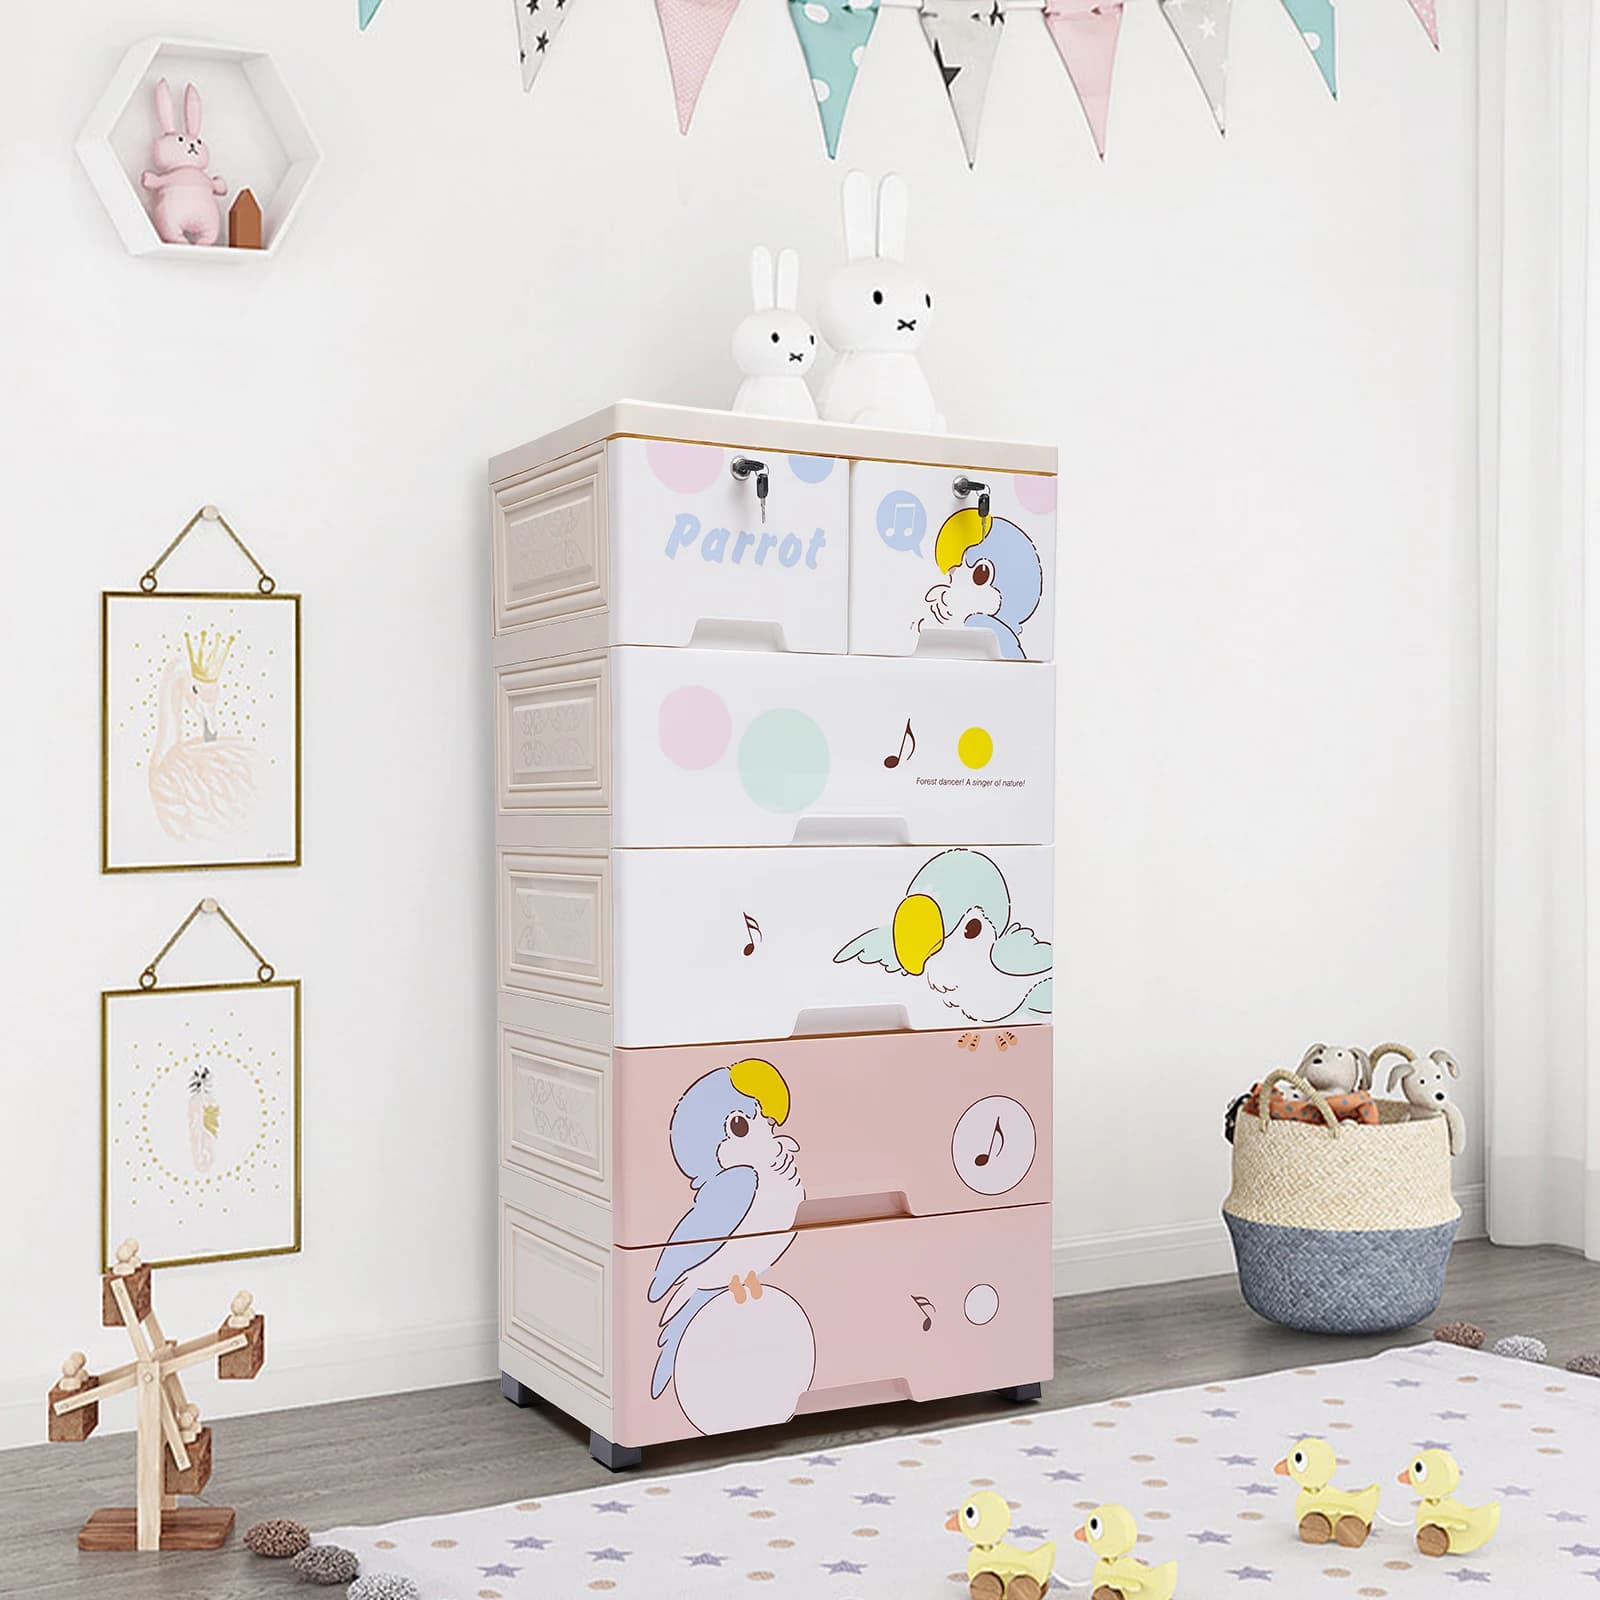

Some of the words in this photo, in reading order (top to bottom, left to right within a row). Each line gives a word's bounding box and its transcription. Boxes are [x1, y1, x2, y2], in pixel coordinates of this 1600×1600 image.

[665, 512, 826, 570] Parrot
[916, 777, 938, 786] Forest
[938, 777, 965, 786] dancer!
[965, 778, 971, 786] A
[972, 778, 993, 788] singer
[994, 778, 1002, 786] of
[1002, 779, 1026, 788] nature!
